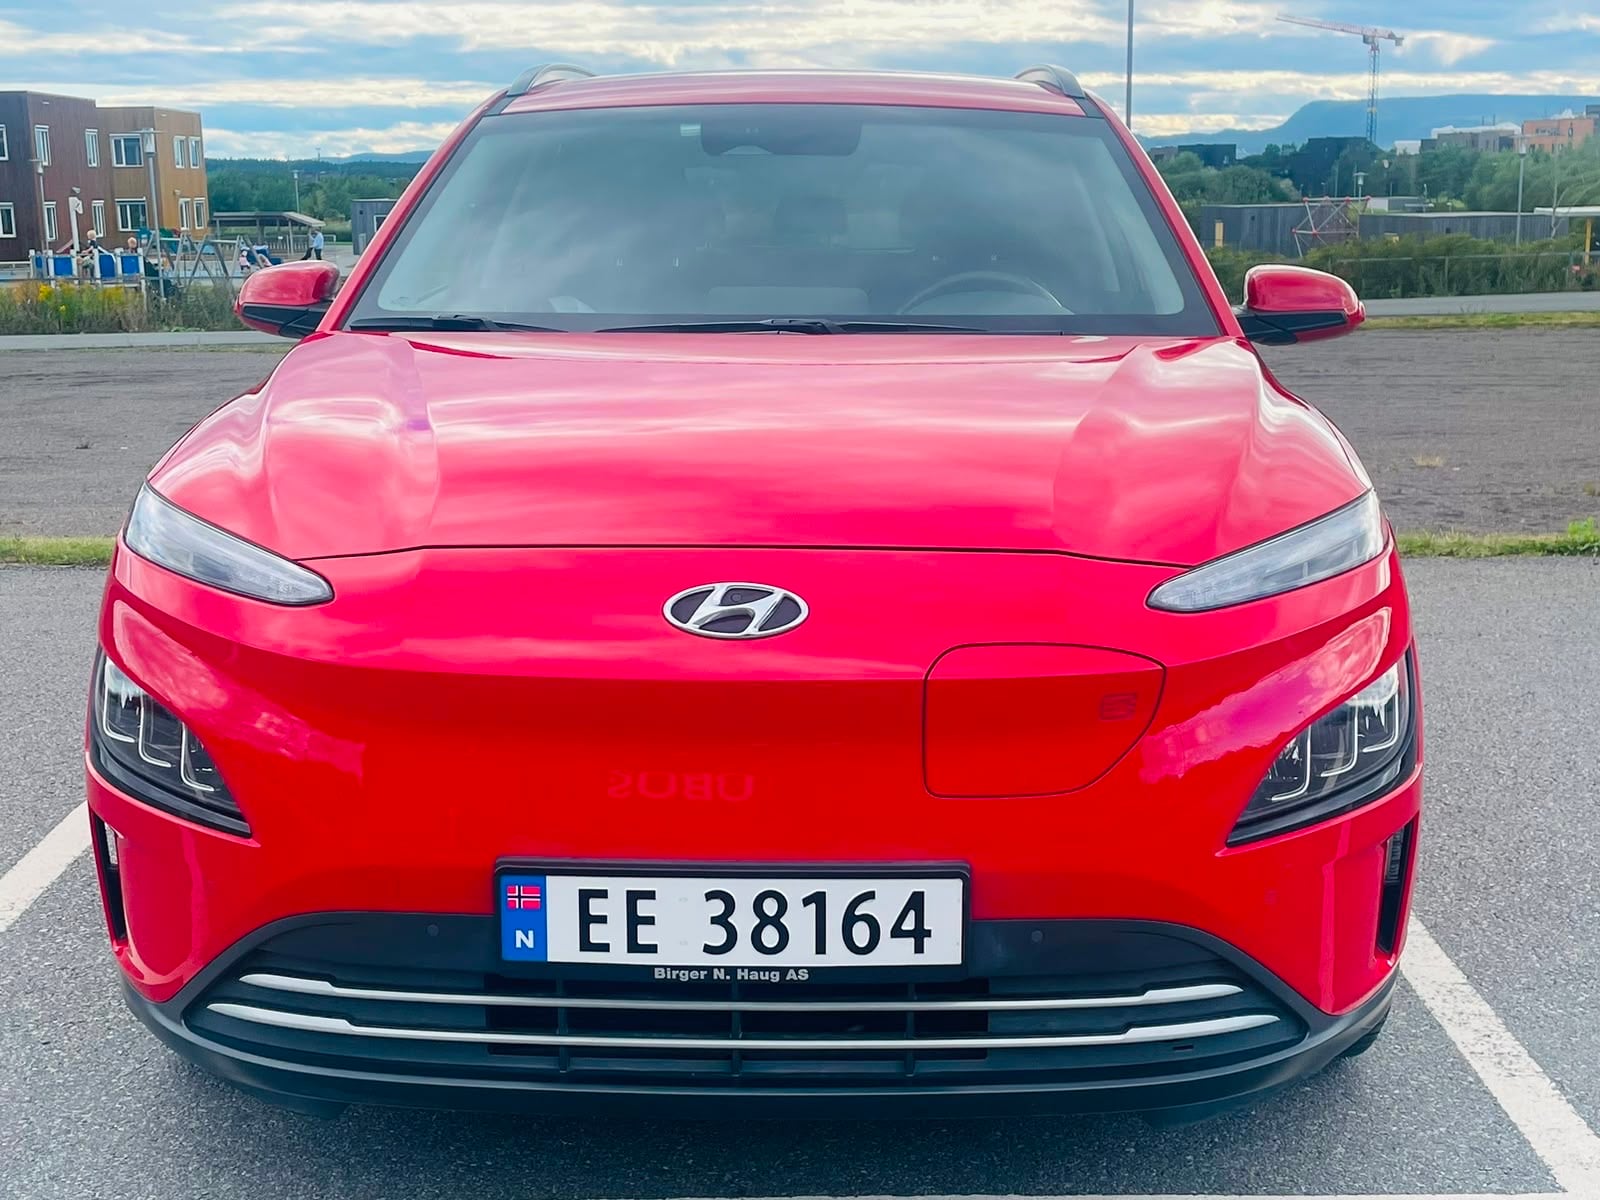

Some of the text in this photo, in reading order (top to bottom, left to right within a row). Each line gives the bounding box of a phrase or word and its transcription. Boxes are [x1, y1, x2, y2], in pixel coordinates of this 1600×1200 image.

[578, 888, 933, 956] EE 38164
[515, 930, 535, 949] N
[653, 967, 809, 983] Birger N. Haug AS
